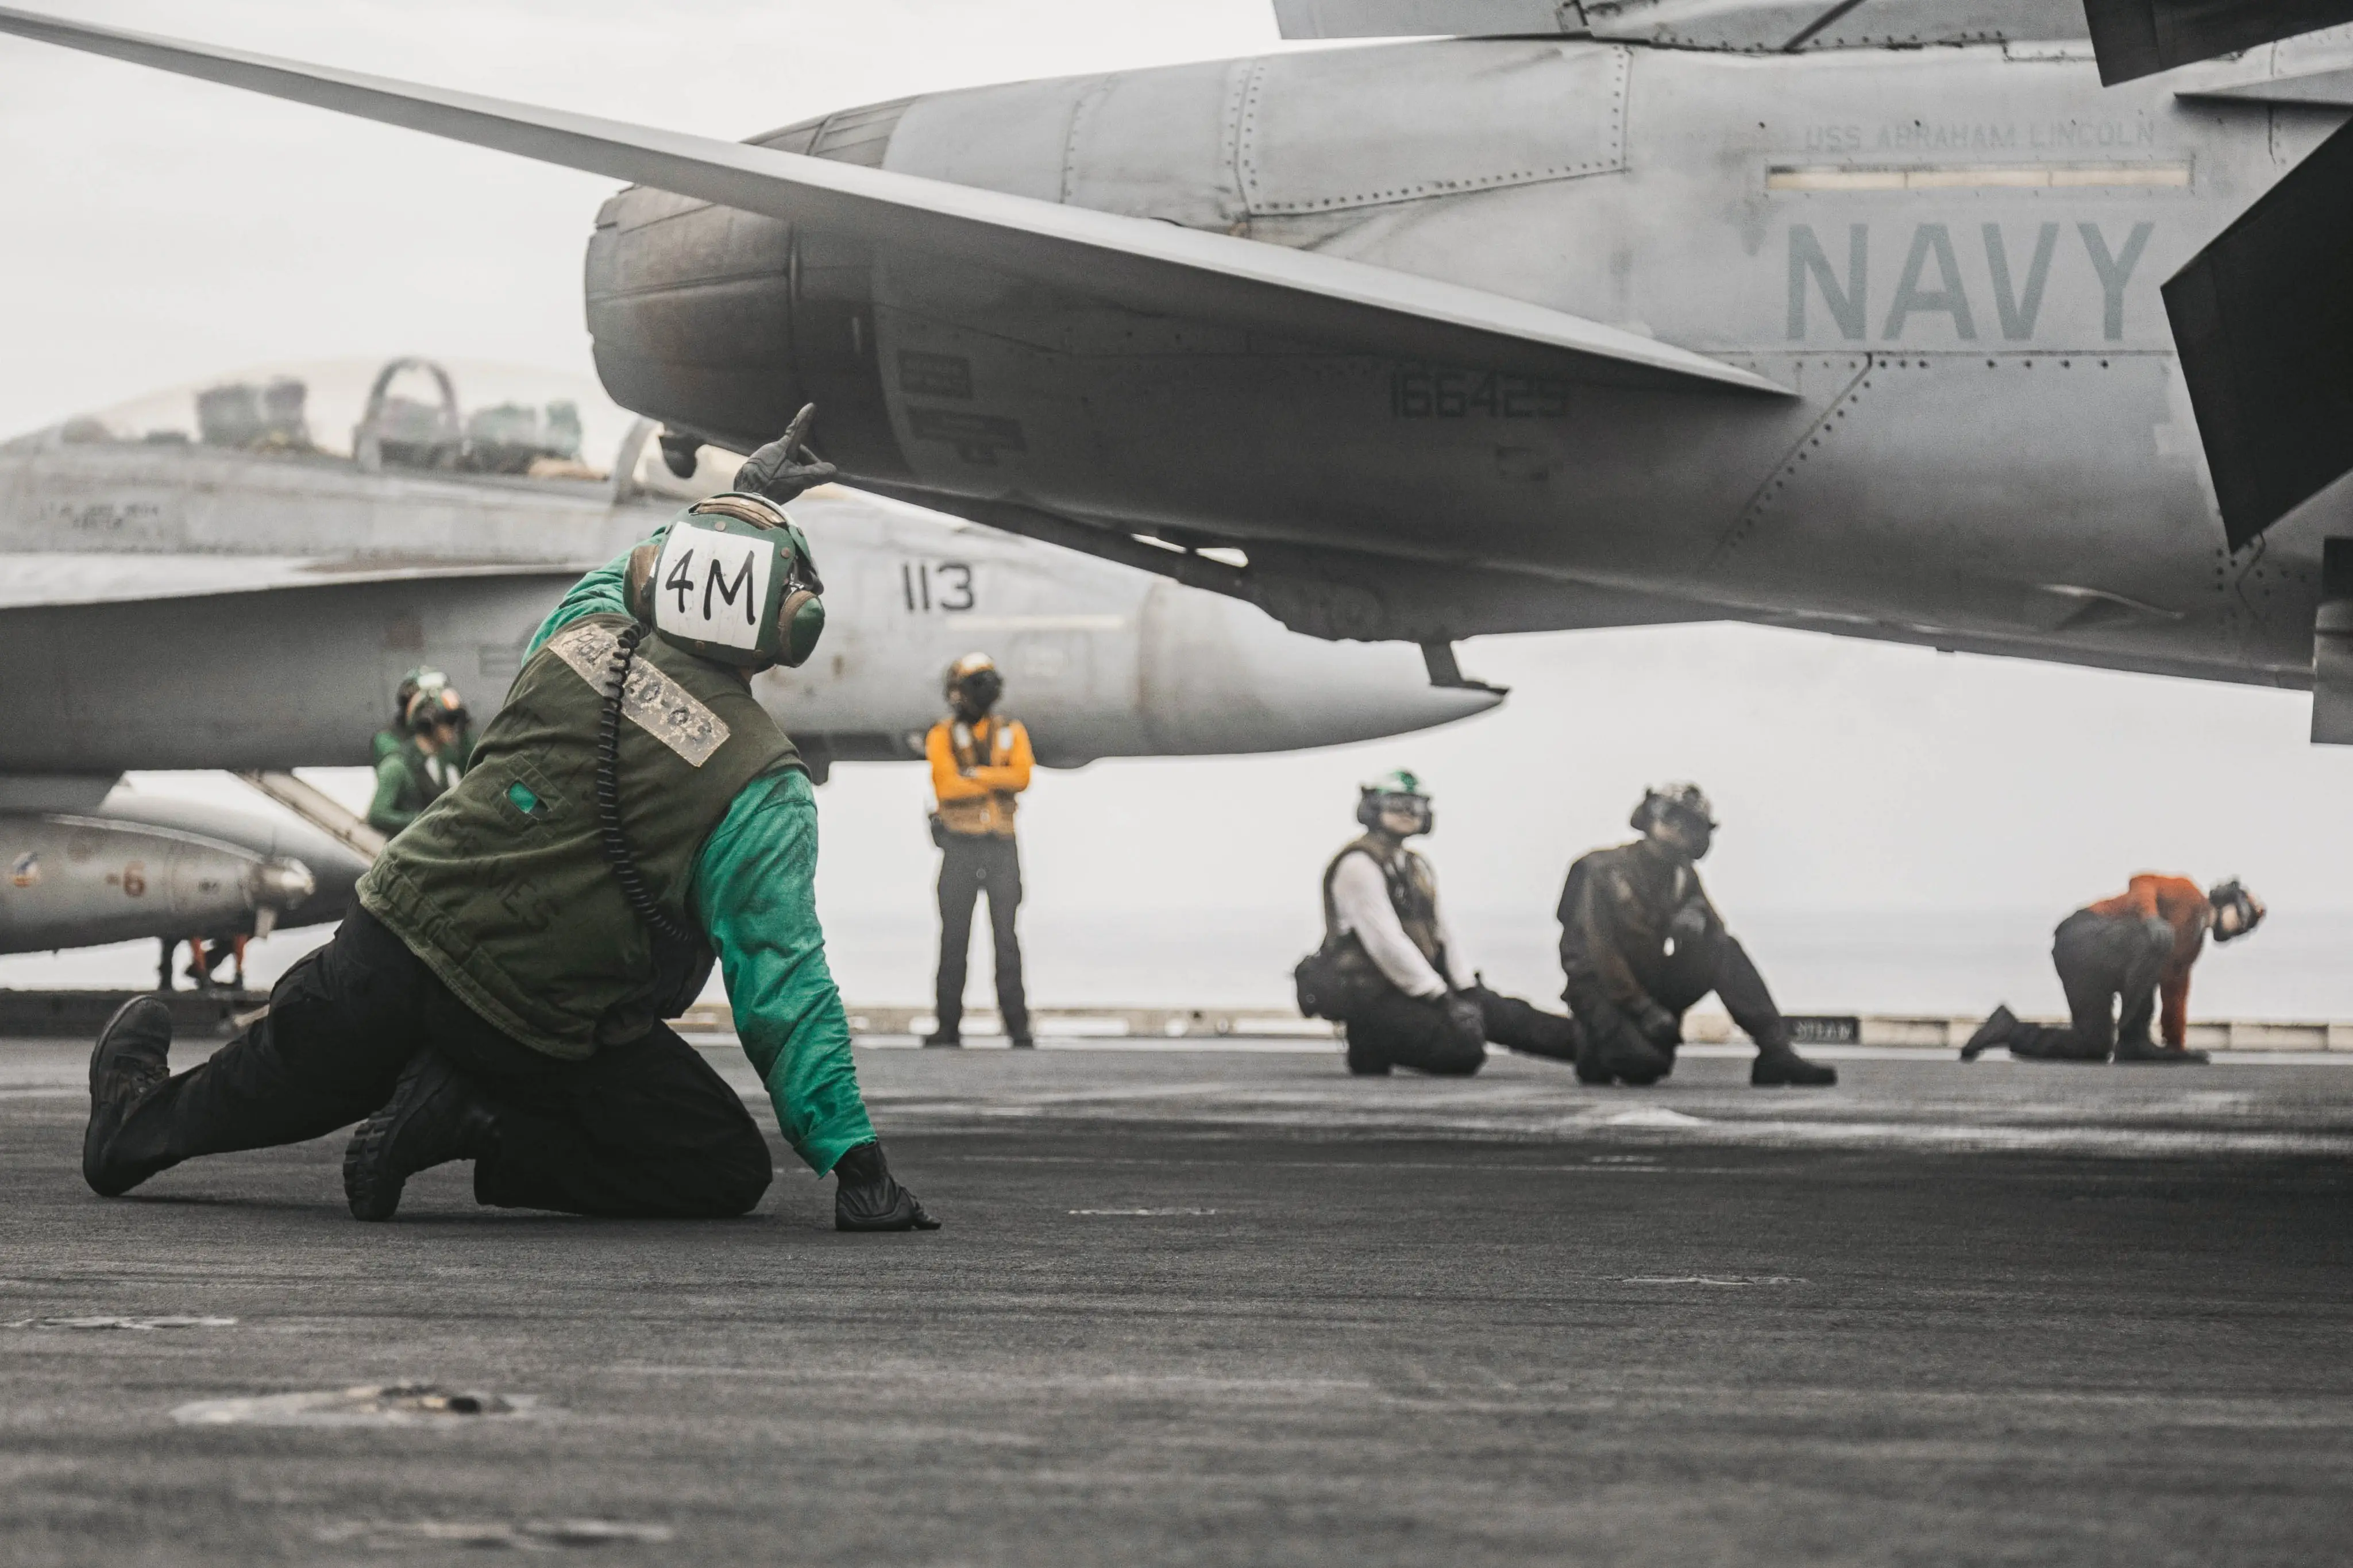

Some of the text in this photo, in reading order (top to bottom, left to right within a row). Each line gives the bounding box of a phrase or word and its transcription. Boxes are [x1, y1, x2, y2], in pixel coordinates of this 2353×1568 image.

[1806, 120, 2155, 151] USS ABRAHAM LINCOLN
[1787, 222, 2156, 341] NAVY
[665, 549, 755, 625] 4M
[902, 561, 975, 613] 113
